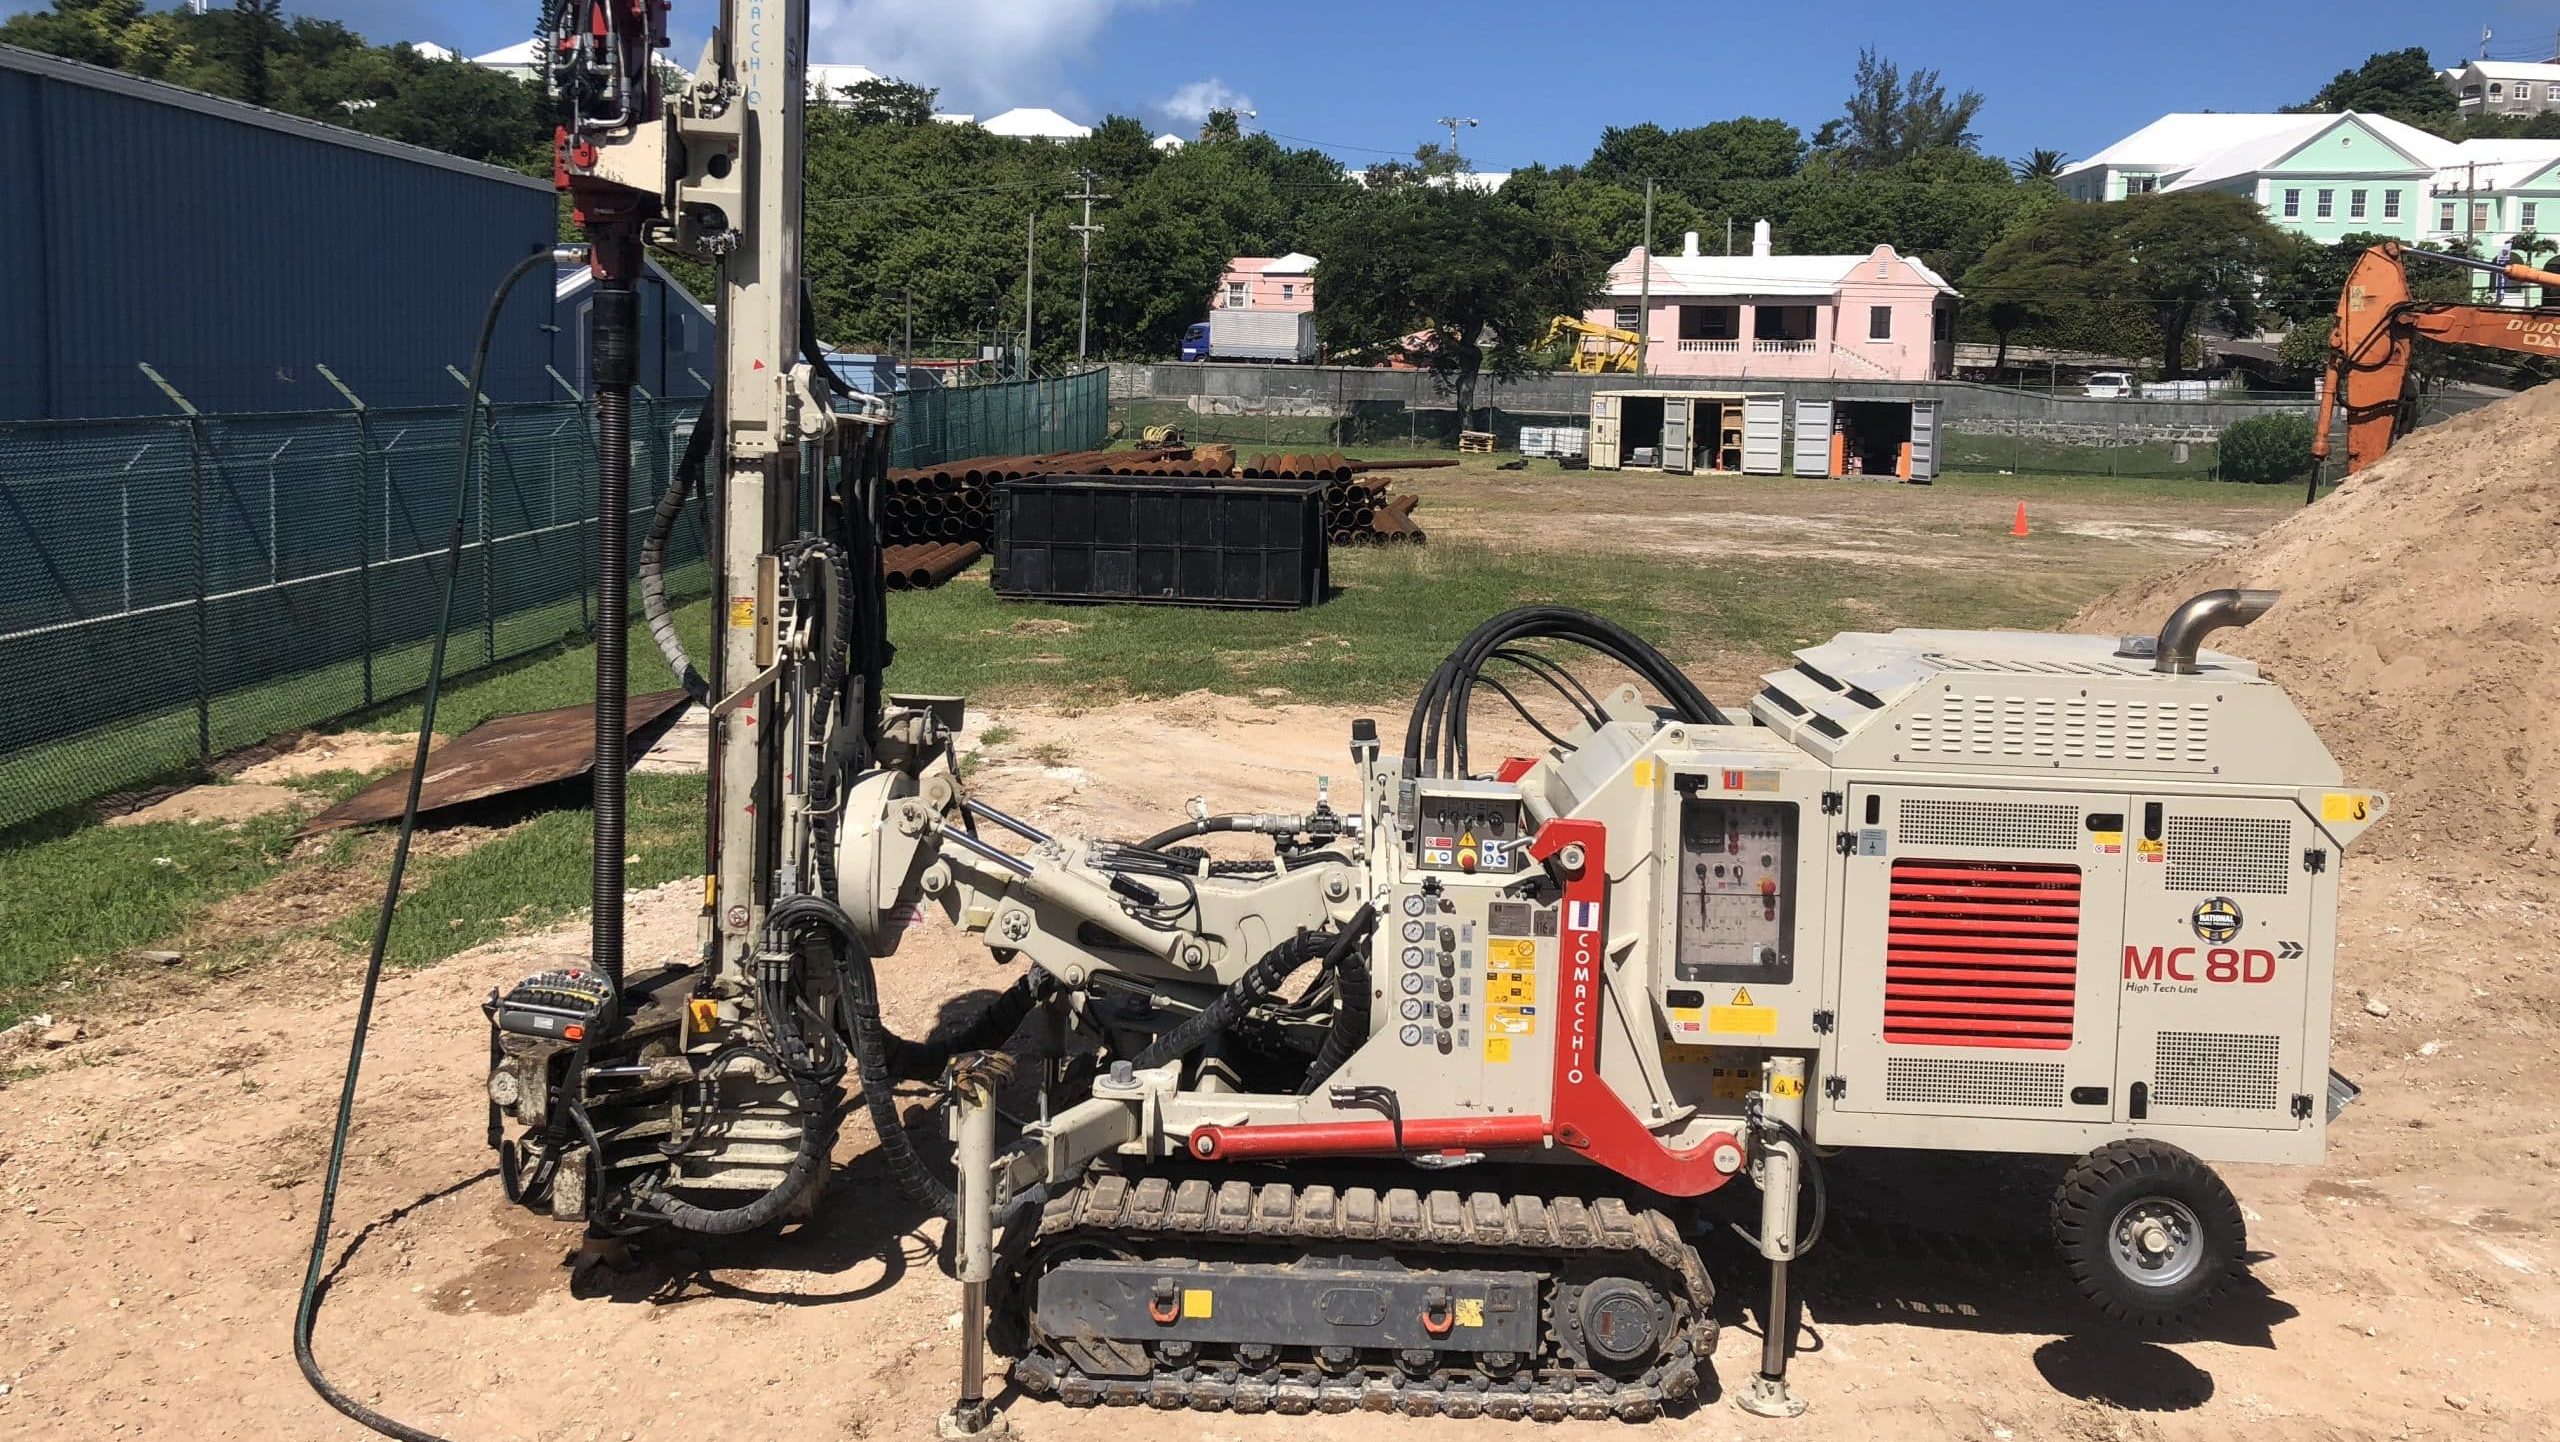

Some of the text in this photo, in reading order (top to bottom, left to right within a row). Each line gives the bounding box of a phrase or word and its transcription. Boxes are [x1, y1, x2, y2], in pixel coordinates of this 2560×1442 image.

[748, 0, 761, 104] ACCHIO
[2522, 333, 2560, 348] DA
[2199, 914, 2234, 923] NATIONAL
[2125, 982, 2198, 994] High Tech Line
[1568, 933, 1590, 1084] COMACCHIO
